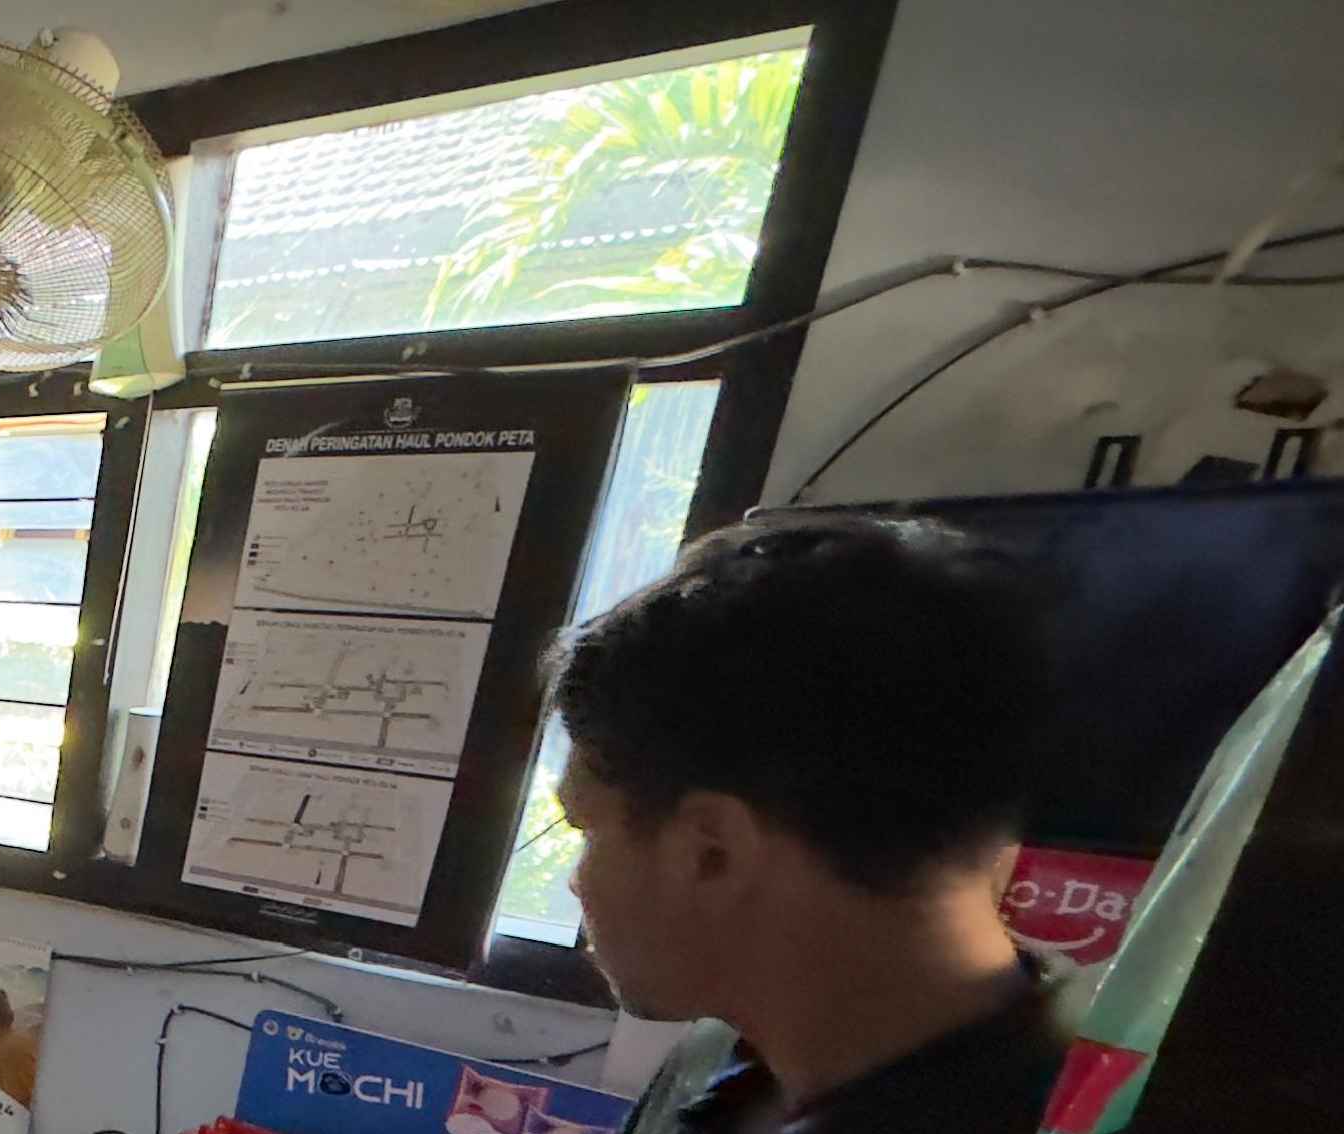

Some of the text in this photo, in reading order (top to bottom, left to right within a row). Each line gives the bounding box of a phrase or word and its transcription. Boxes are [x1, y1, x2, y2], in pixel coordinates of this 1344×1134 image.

[311, 434, 394, 451] PERINGATAN
[395, 433, 432, 448] HAUL
[434, 431, 497, 447] PONDOK
[499, 430, 535, 446] PETA
[287, 1048, 343, 1071] KUE
